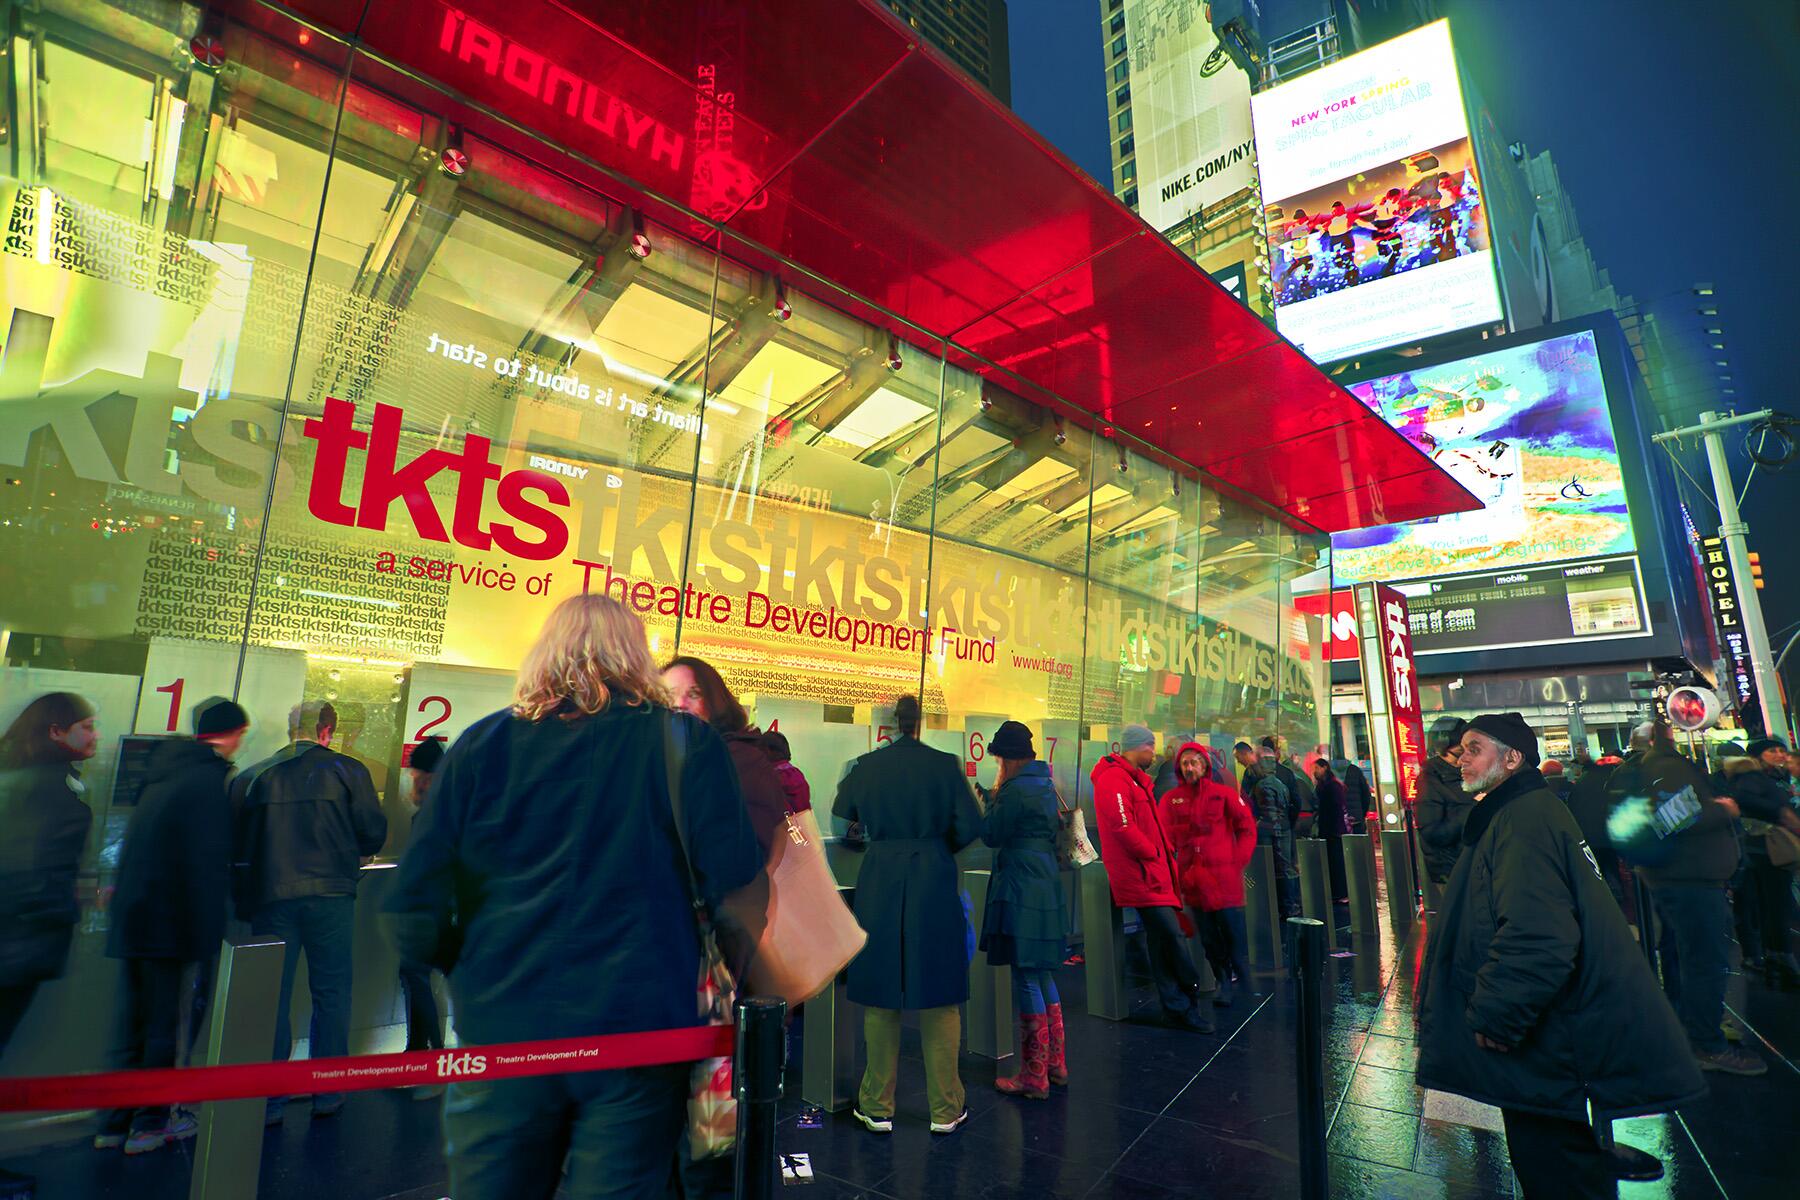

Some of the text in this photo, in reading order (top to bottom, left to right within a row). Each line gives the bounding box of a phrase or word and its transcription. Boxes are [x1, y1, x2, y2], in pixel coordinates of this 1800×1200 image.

[1291, 110, 1319, 127] NEW
[1323, 96, 1357, 115] YORK
[1361, 77, 1411, 100] SPRING
[1161, 138, 1257, 202] NIKE.COM/NY
[304, 396, 571, 562] tkts
[1386, 556, 1425, 572] Love
[1447, 548, 1488, 564] New
[1492, 535, 1597, 560] Beginnings
[1564, 565, 1606, 577] weather
[1432, 584, 1443, 593] tv
[1496, 573, 1529, 586] mobile
[1708, 551, 1737, 626] HOTEL
[376, 549, 1073, 678] a service of Theatre Development Fund www.tdf.org
[1386, 601, 1412, 709] tkts
[157, 678, 184, 732] 1
[414, 695, 453, 743] 2
[969, 731, 985, 762] 6
[1045, 736, 1058, 765] 7
[312, 1047, 599, 1080] Theatre Development Fund tkts Theatre Development Fund
